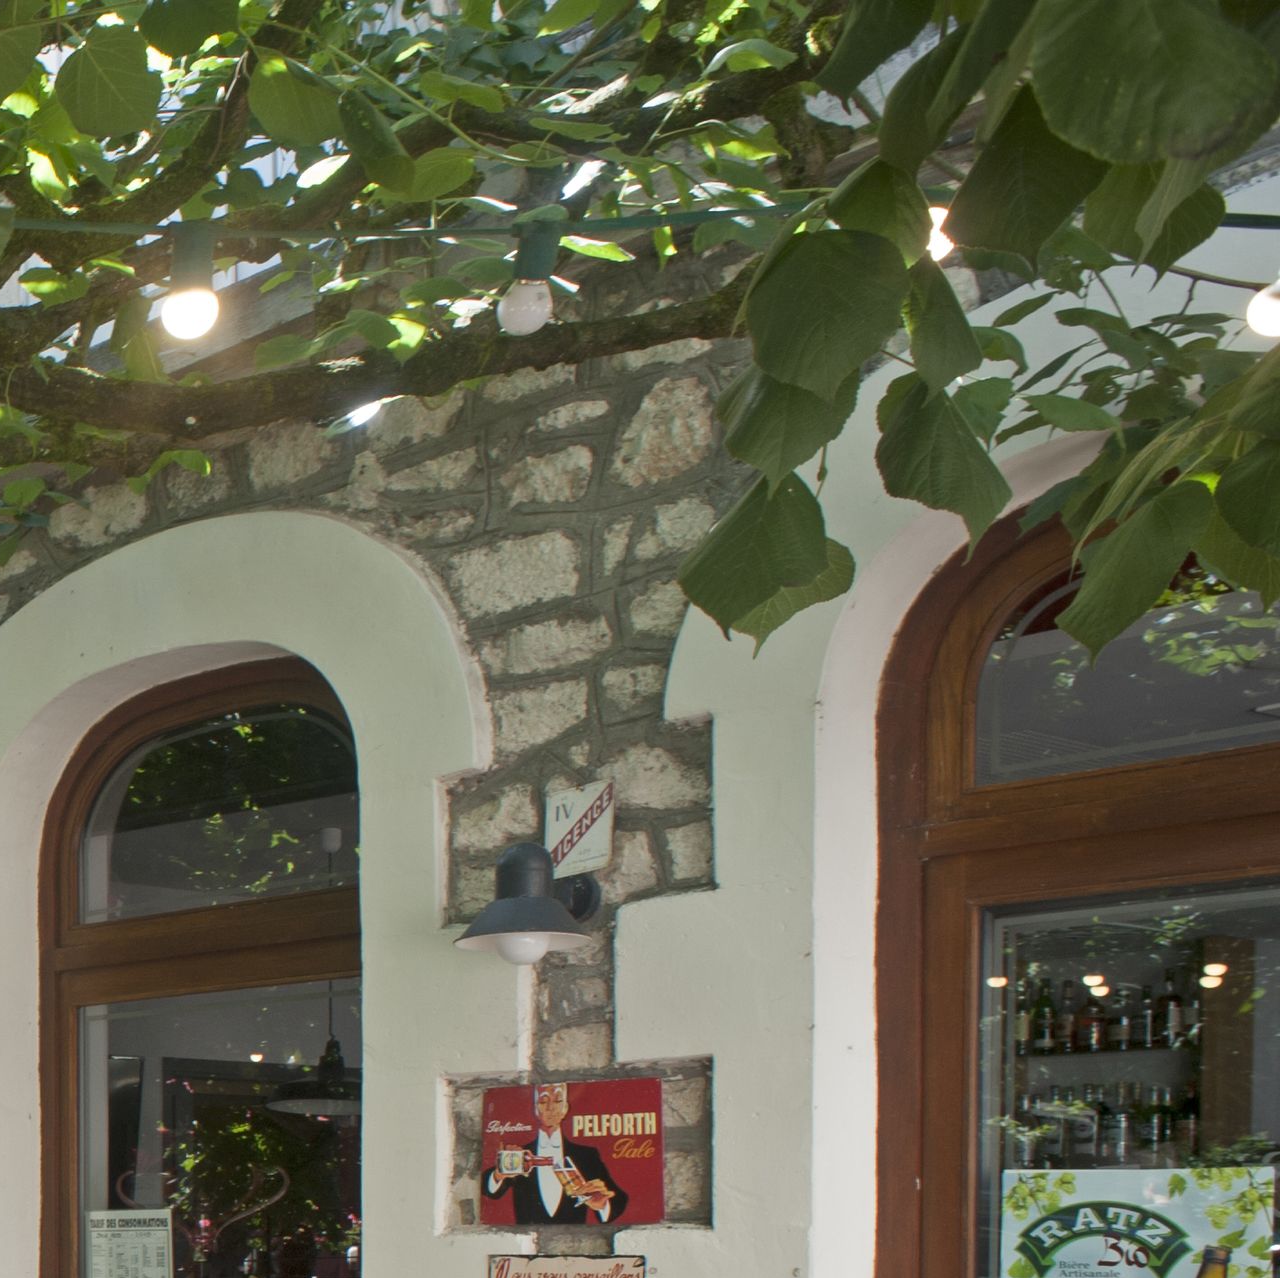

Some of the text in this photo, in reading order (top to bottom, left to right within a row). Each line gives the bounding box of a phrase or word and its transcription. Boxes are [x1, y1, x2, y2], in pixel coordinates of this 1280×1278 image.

[556, 802, 574, 822] IV
[552, 788, 611, 866] ICENCE
[572, 1112, 657, 1137] PELFORTH
[612, 1138, 655, 1159] Pale
[106, 1218, 117, 1228] DES
[1030, 1207, 1172, 1248] RATZ
[1058, 1260, 1090, 1270] Bière
[1058, 1269, 1121, 1278] Artisanale
